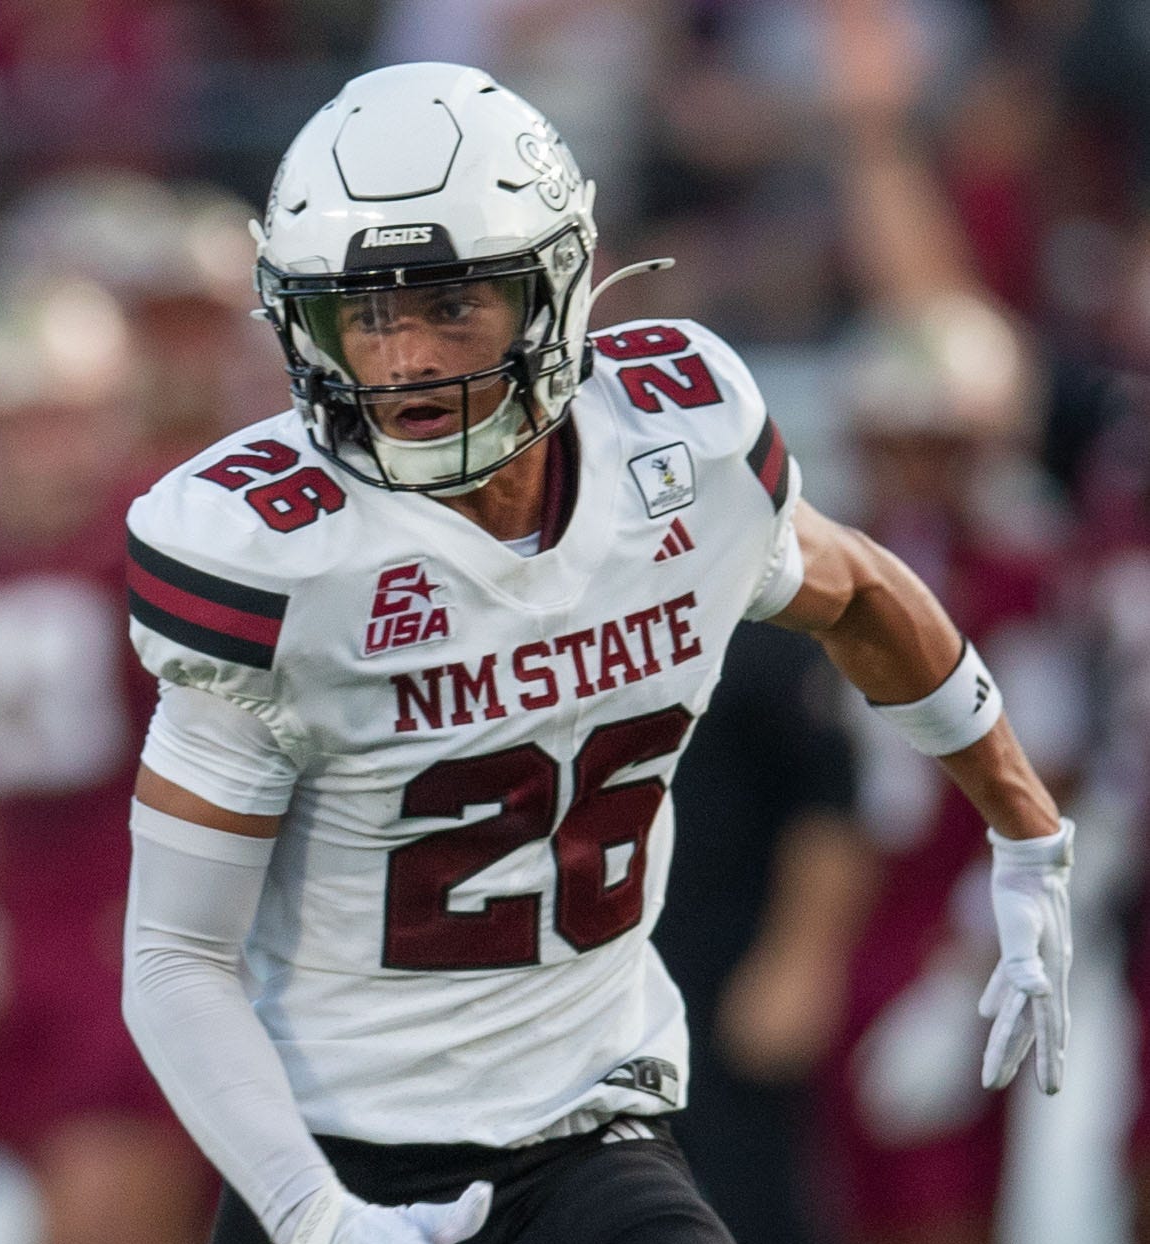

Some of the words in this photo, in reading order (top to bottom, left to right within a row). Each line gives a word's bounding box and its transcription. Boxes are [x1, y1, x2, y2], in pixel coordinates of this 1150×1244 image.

[361, 226, 433, 249] AGGIES
[593, 325, 725, 414] 26
[191, 439, 347, 534] 26
[364, 606, 450, 655] USA
[389, 652, 508, 733] NM
[511, 590, 703, 712] STATE
[381, 702, 701, 971] 26
